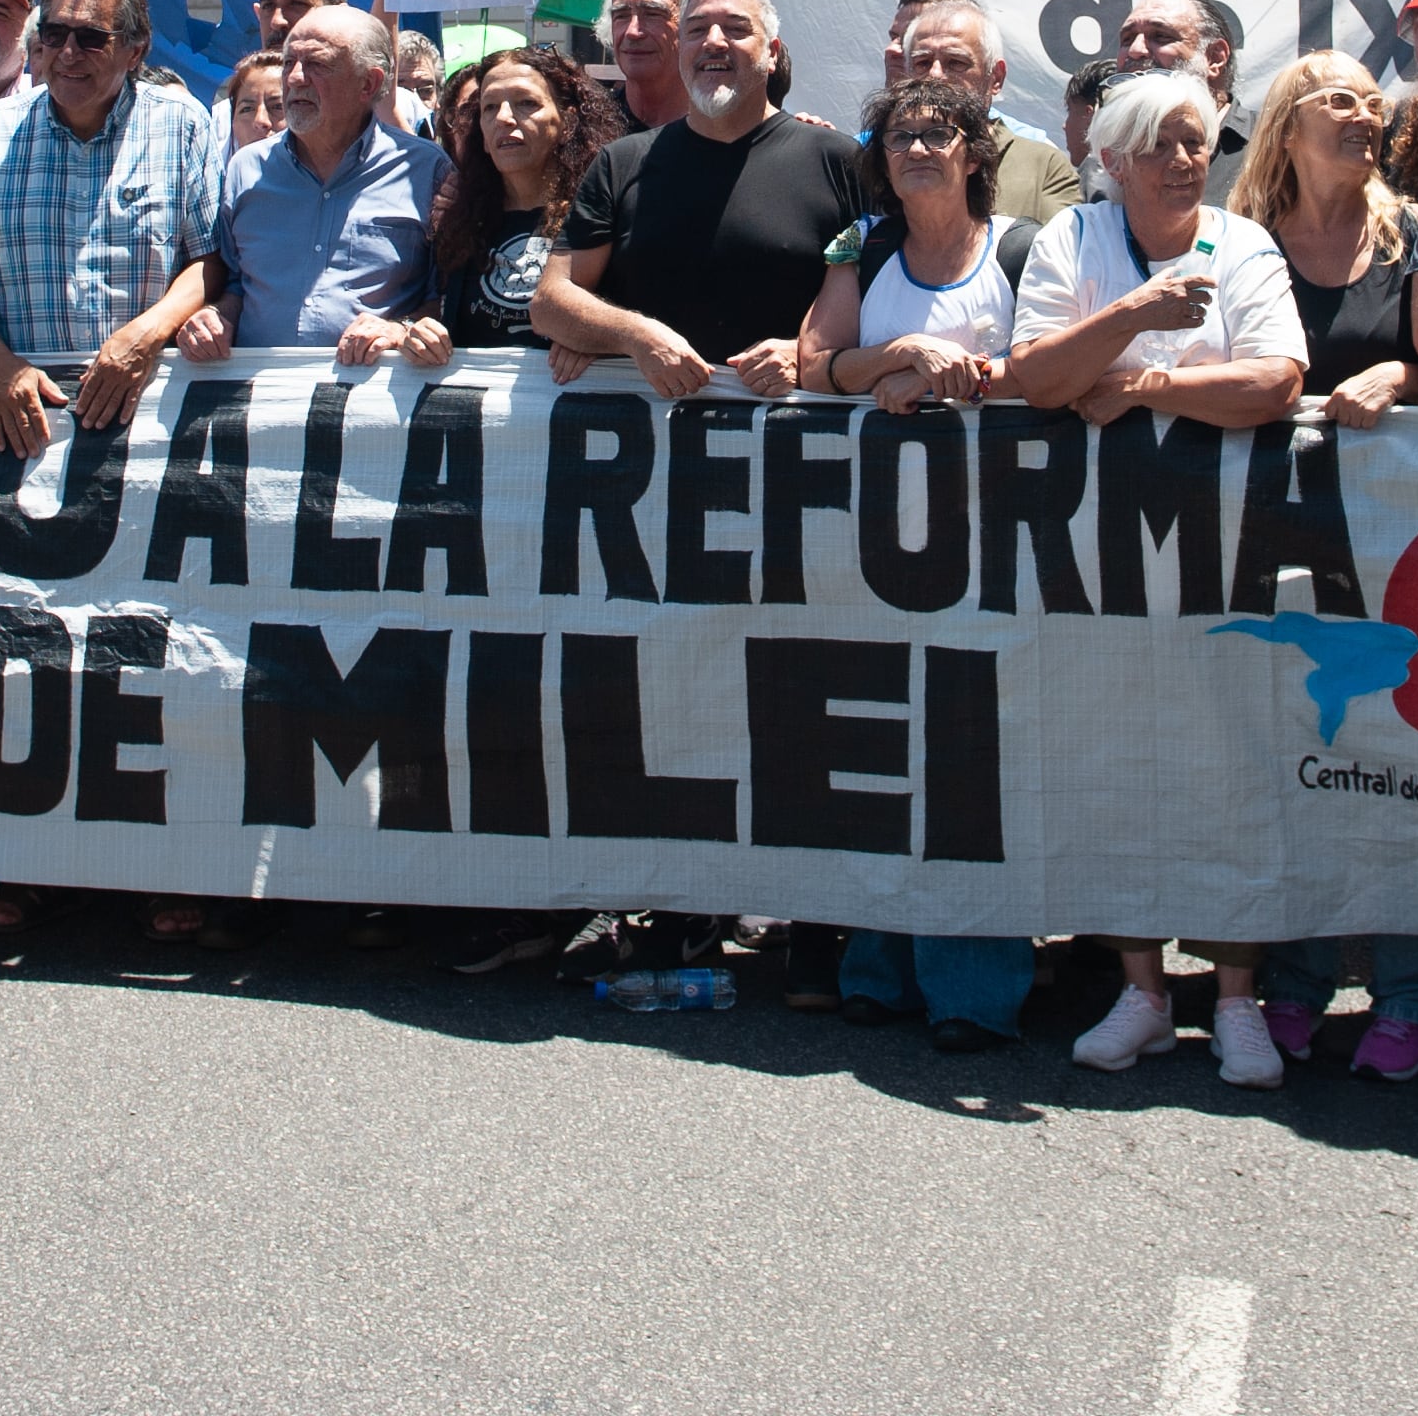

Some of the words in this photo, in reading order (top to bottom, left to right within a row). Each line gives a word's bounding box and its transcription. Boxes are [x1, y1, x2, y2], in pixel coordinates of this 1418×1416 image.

[143, 380, 254, 586] A
[291, 380, 490, 597] LA
[540, 391, 1369, 619] REFORMA
[242, 622, 1006, 864] MILEI
[1298, 755, 1395, 797] Central
